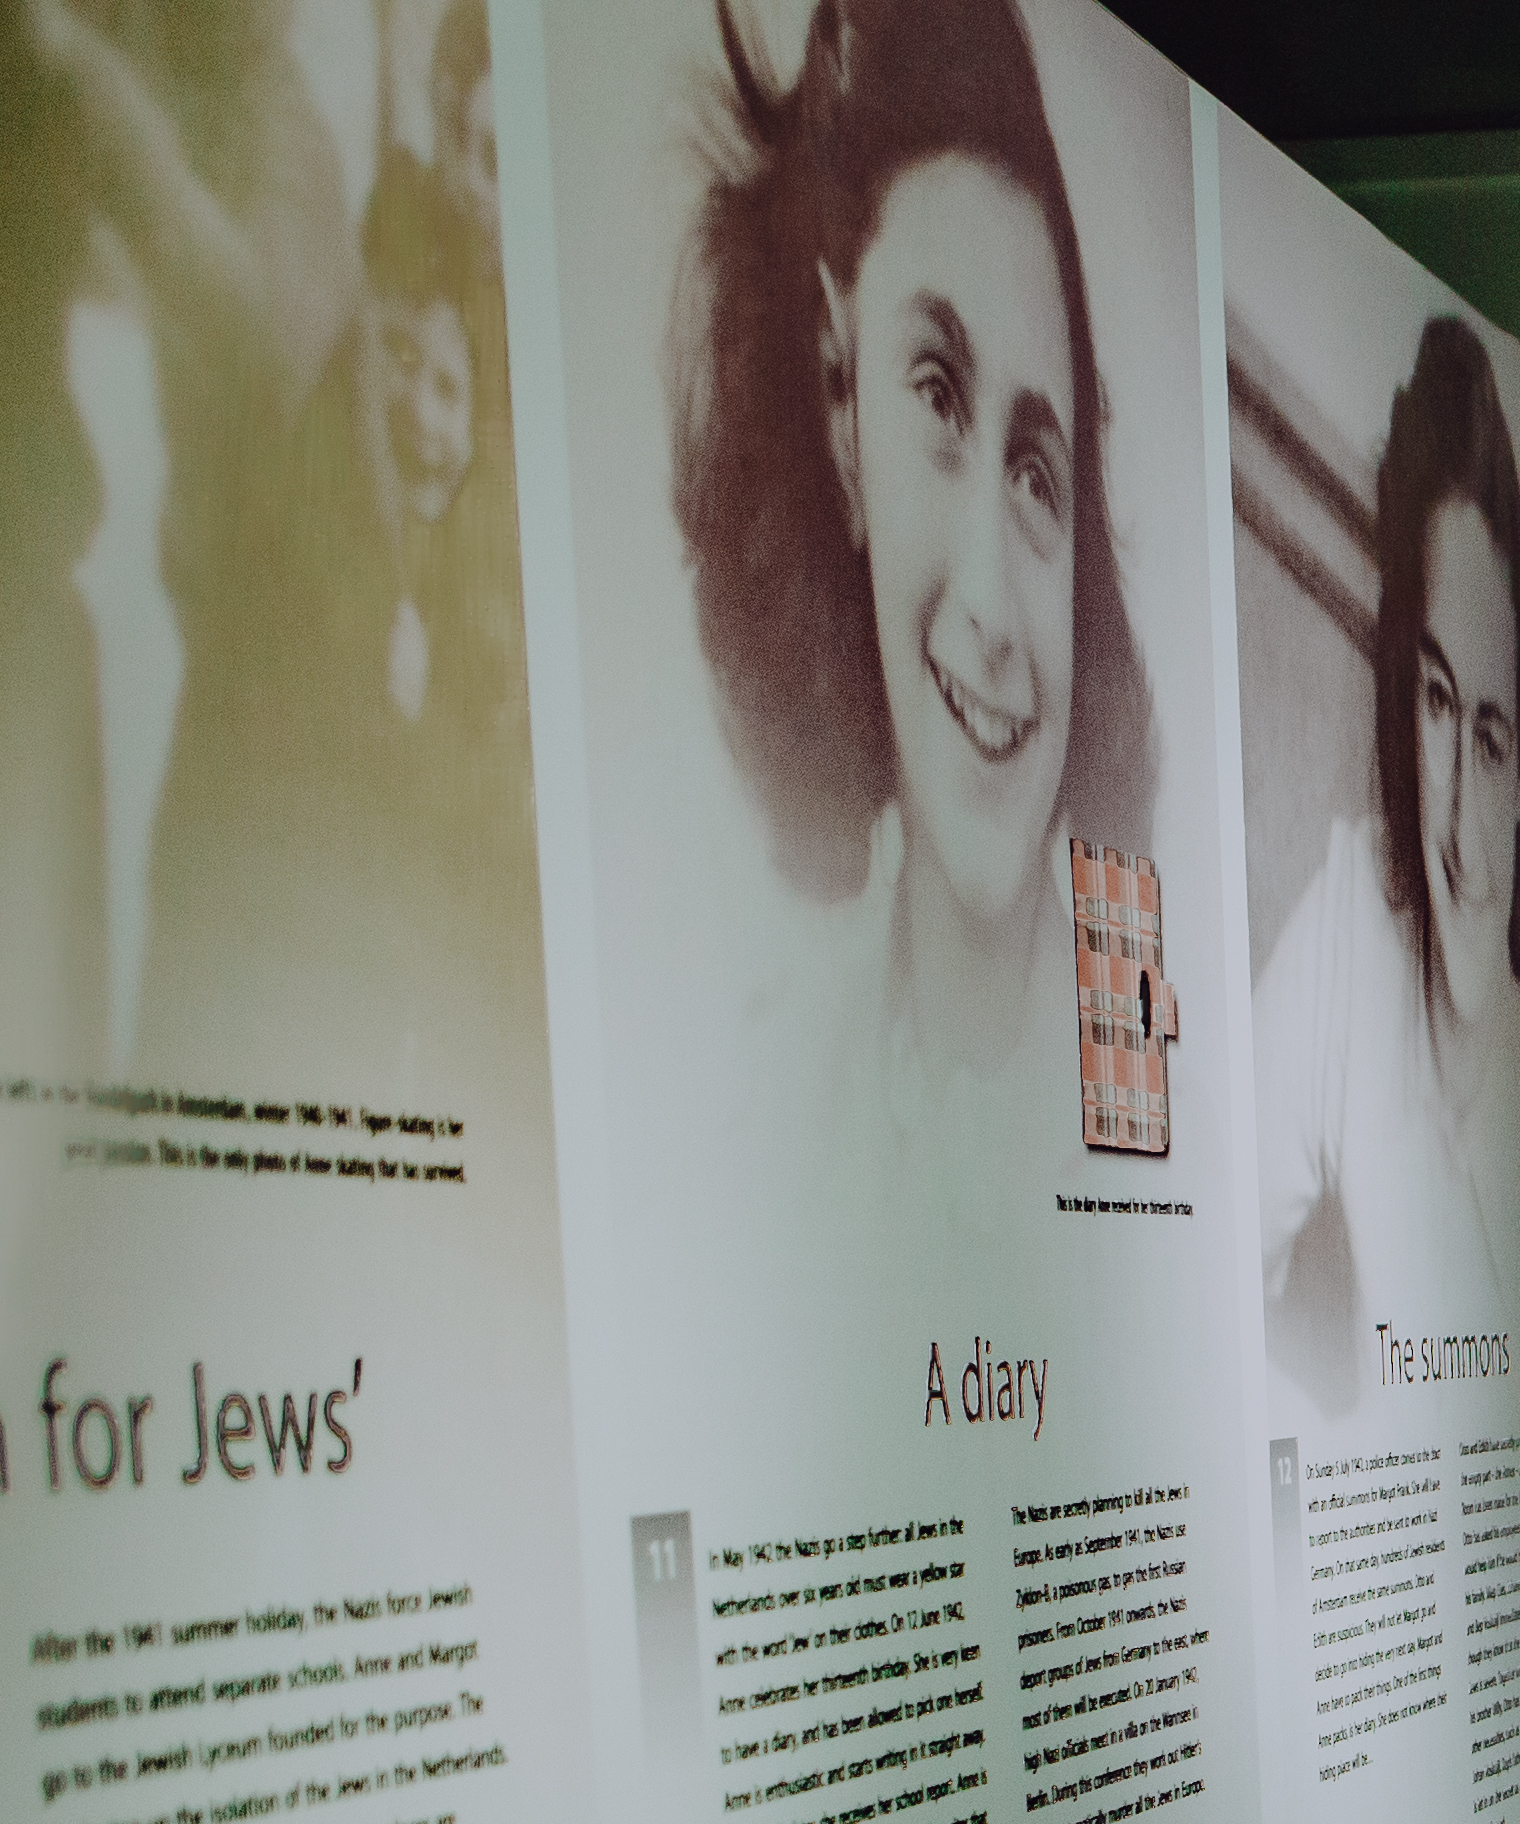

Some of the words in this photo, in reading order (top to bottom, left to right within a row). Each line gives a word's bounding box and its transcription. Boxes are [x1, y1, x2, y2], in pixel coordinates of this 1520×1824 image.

[1375, 1319, 1414, 1386] The
[1420, 1331, 1511, 1383] summons
[924, 1341, 952, 1427] A
[960, 1336, 1048, 1441] diary
[39, 1357, 154, 1493] for
[182, 1357, 364, 1485] Jews'
[1277, 1456, 1293, 1486] 12
[648, 1538, 678, 1582] 11
